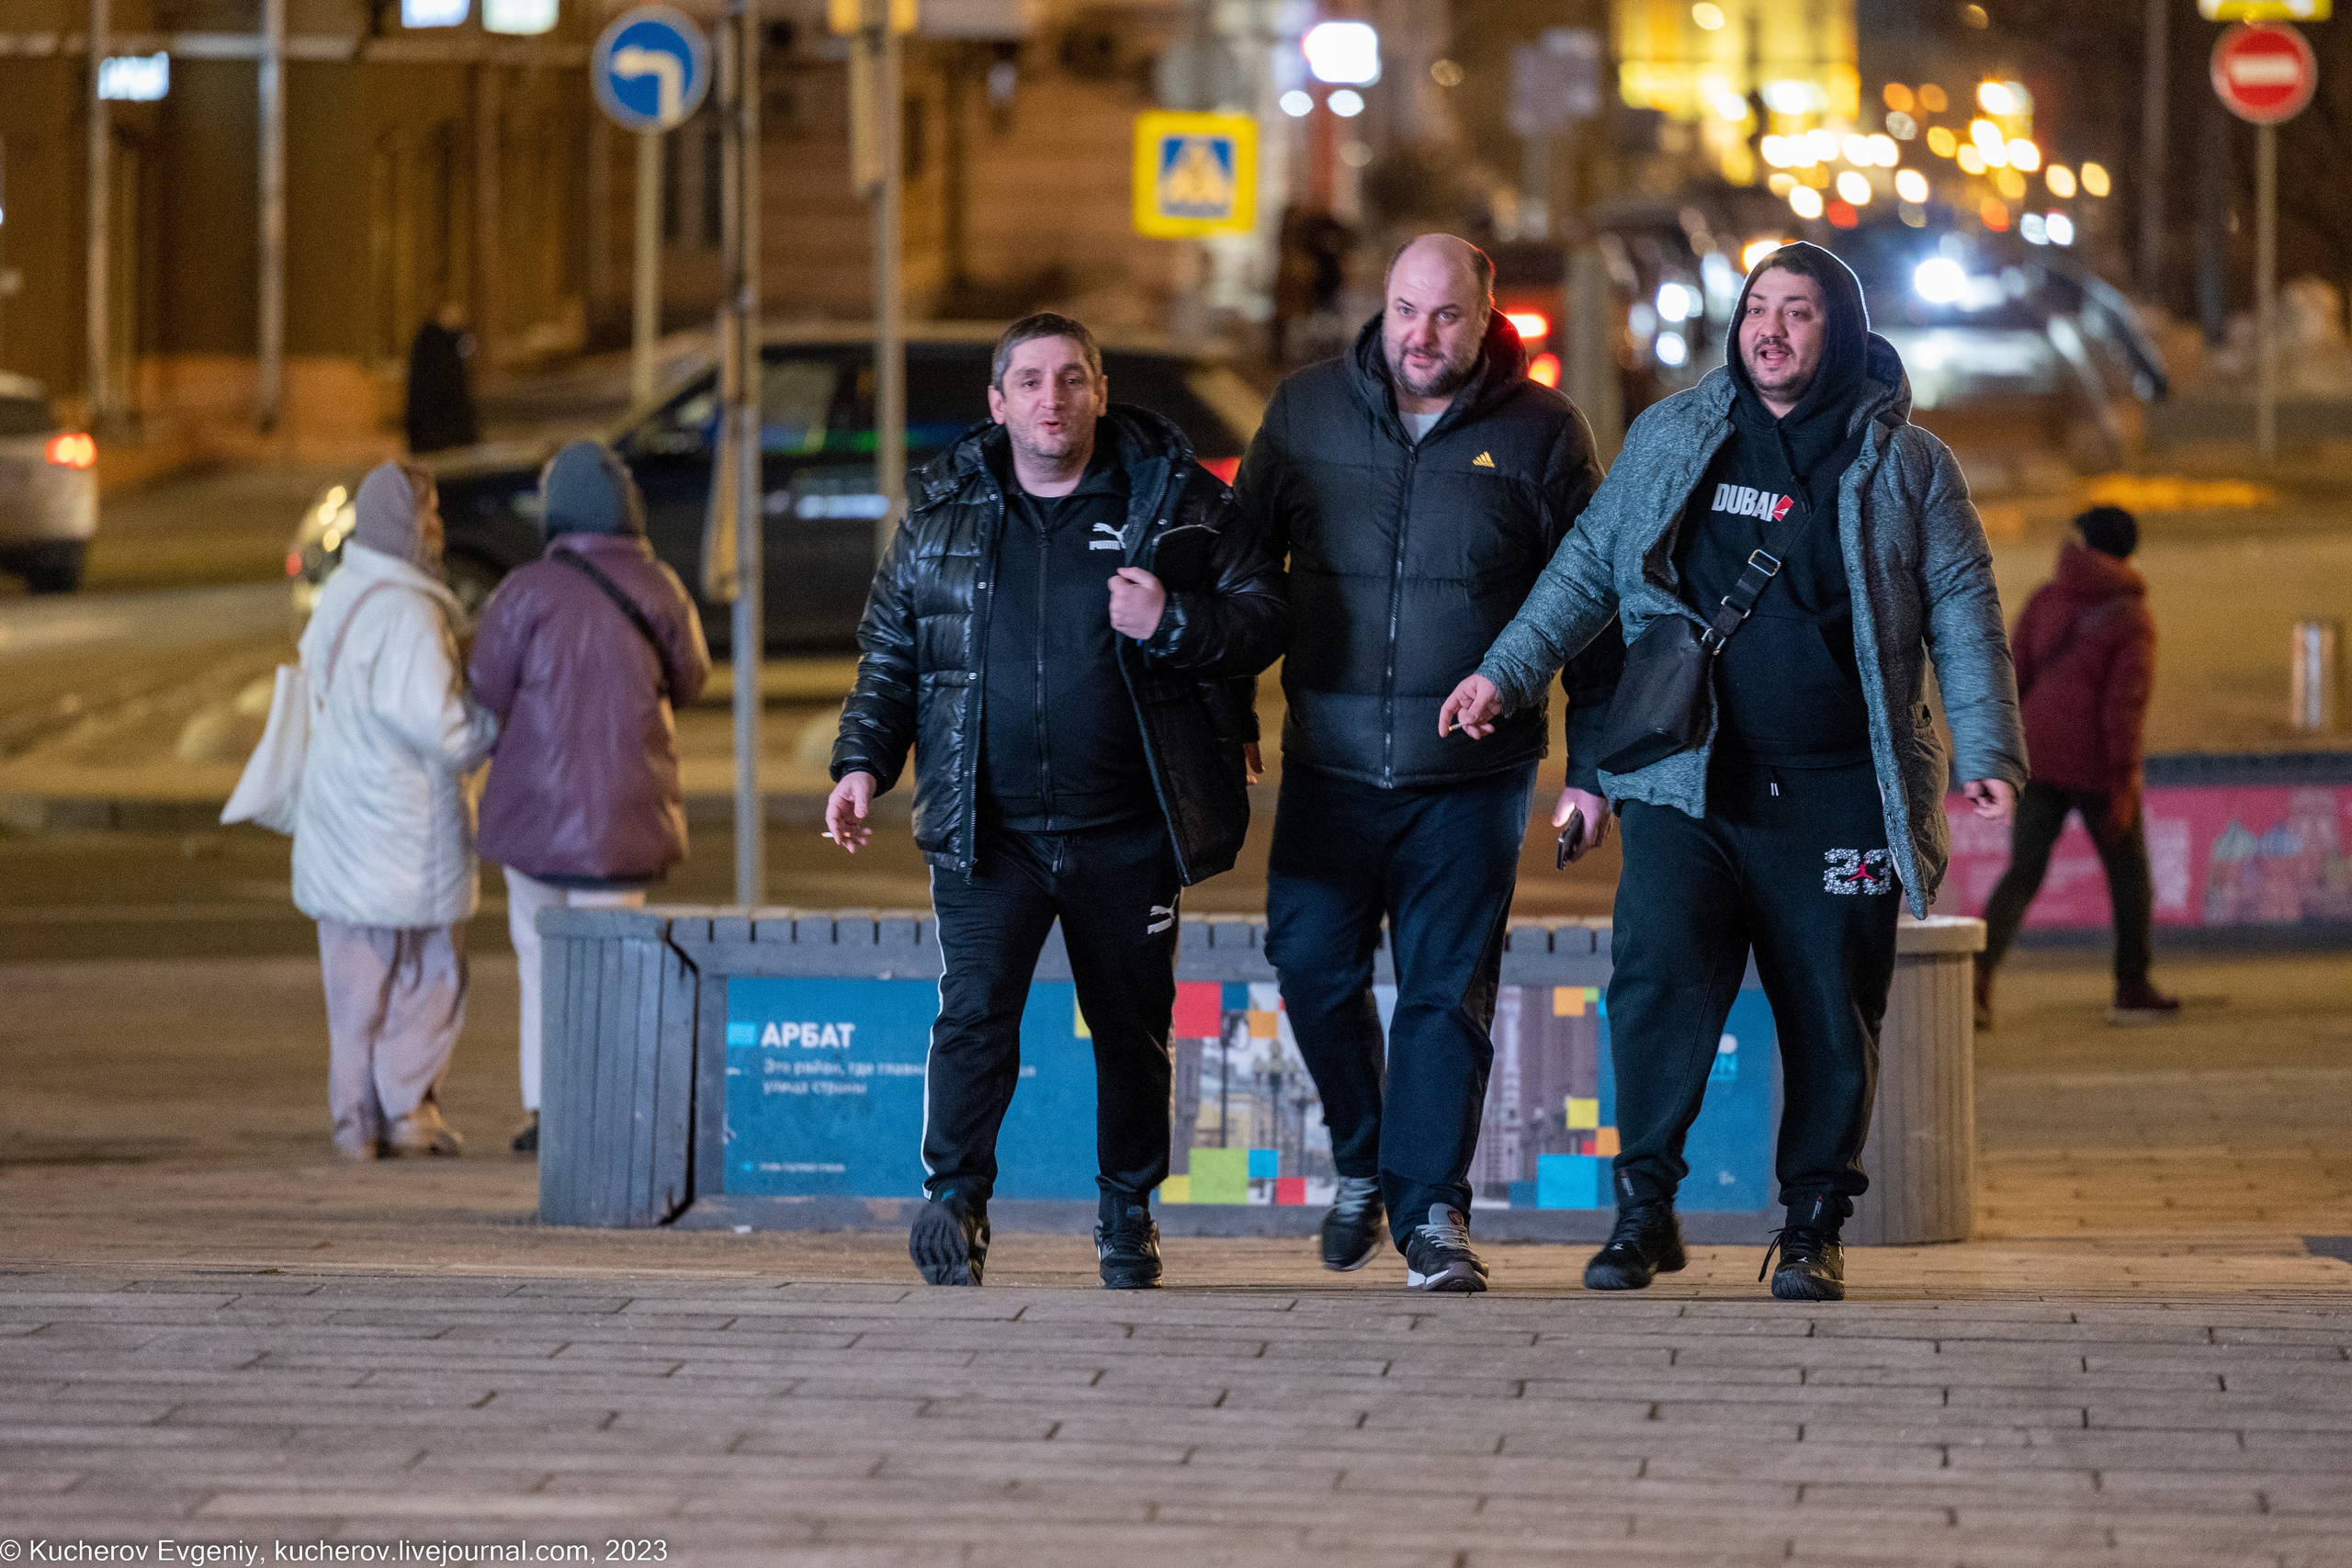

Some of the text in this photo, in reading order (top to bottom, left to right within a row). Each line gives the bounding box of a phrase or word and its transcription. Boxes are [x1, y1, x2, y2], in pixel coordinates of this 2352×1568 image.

[1711, 482, 1780, 522] DUBAI
[1823, 848, 1893, 896] 23
[761, 1021, 856, 1049] АРБАТ
